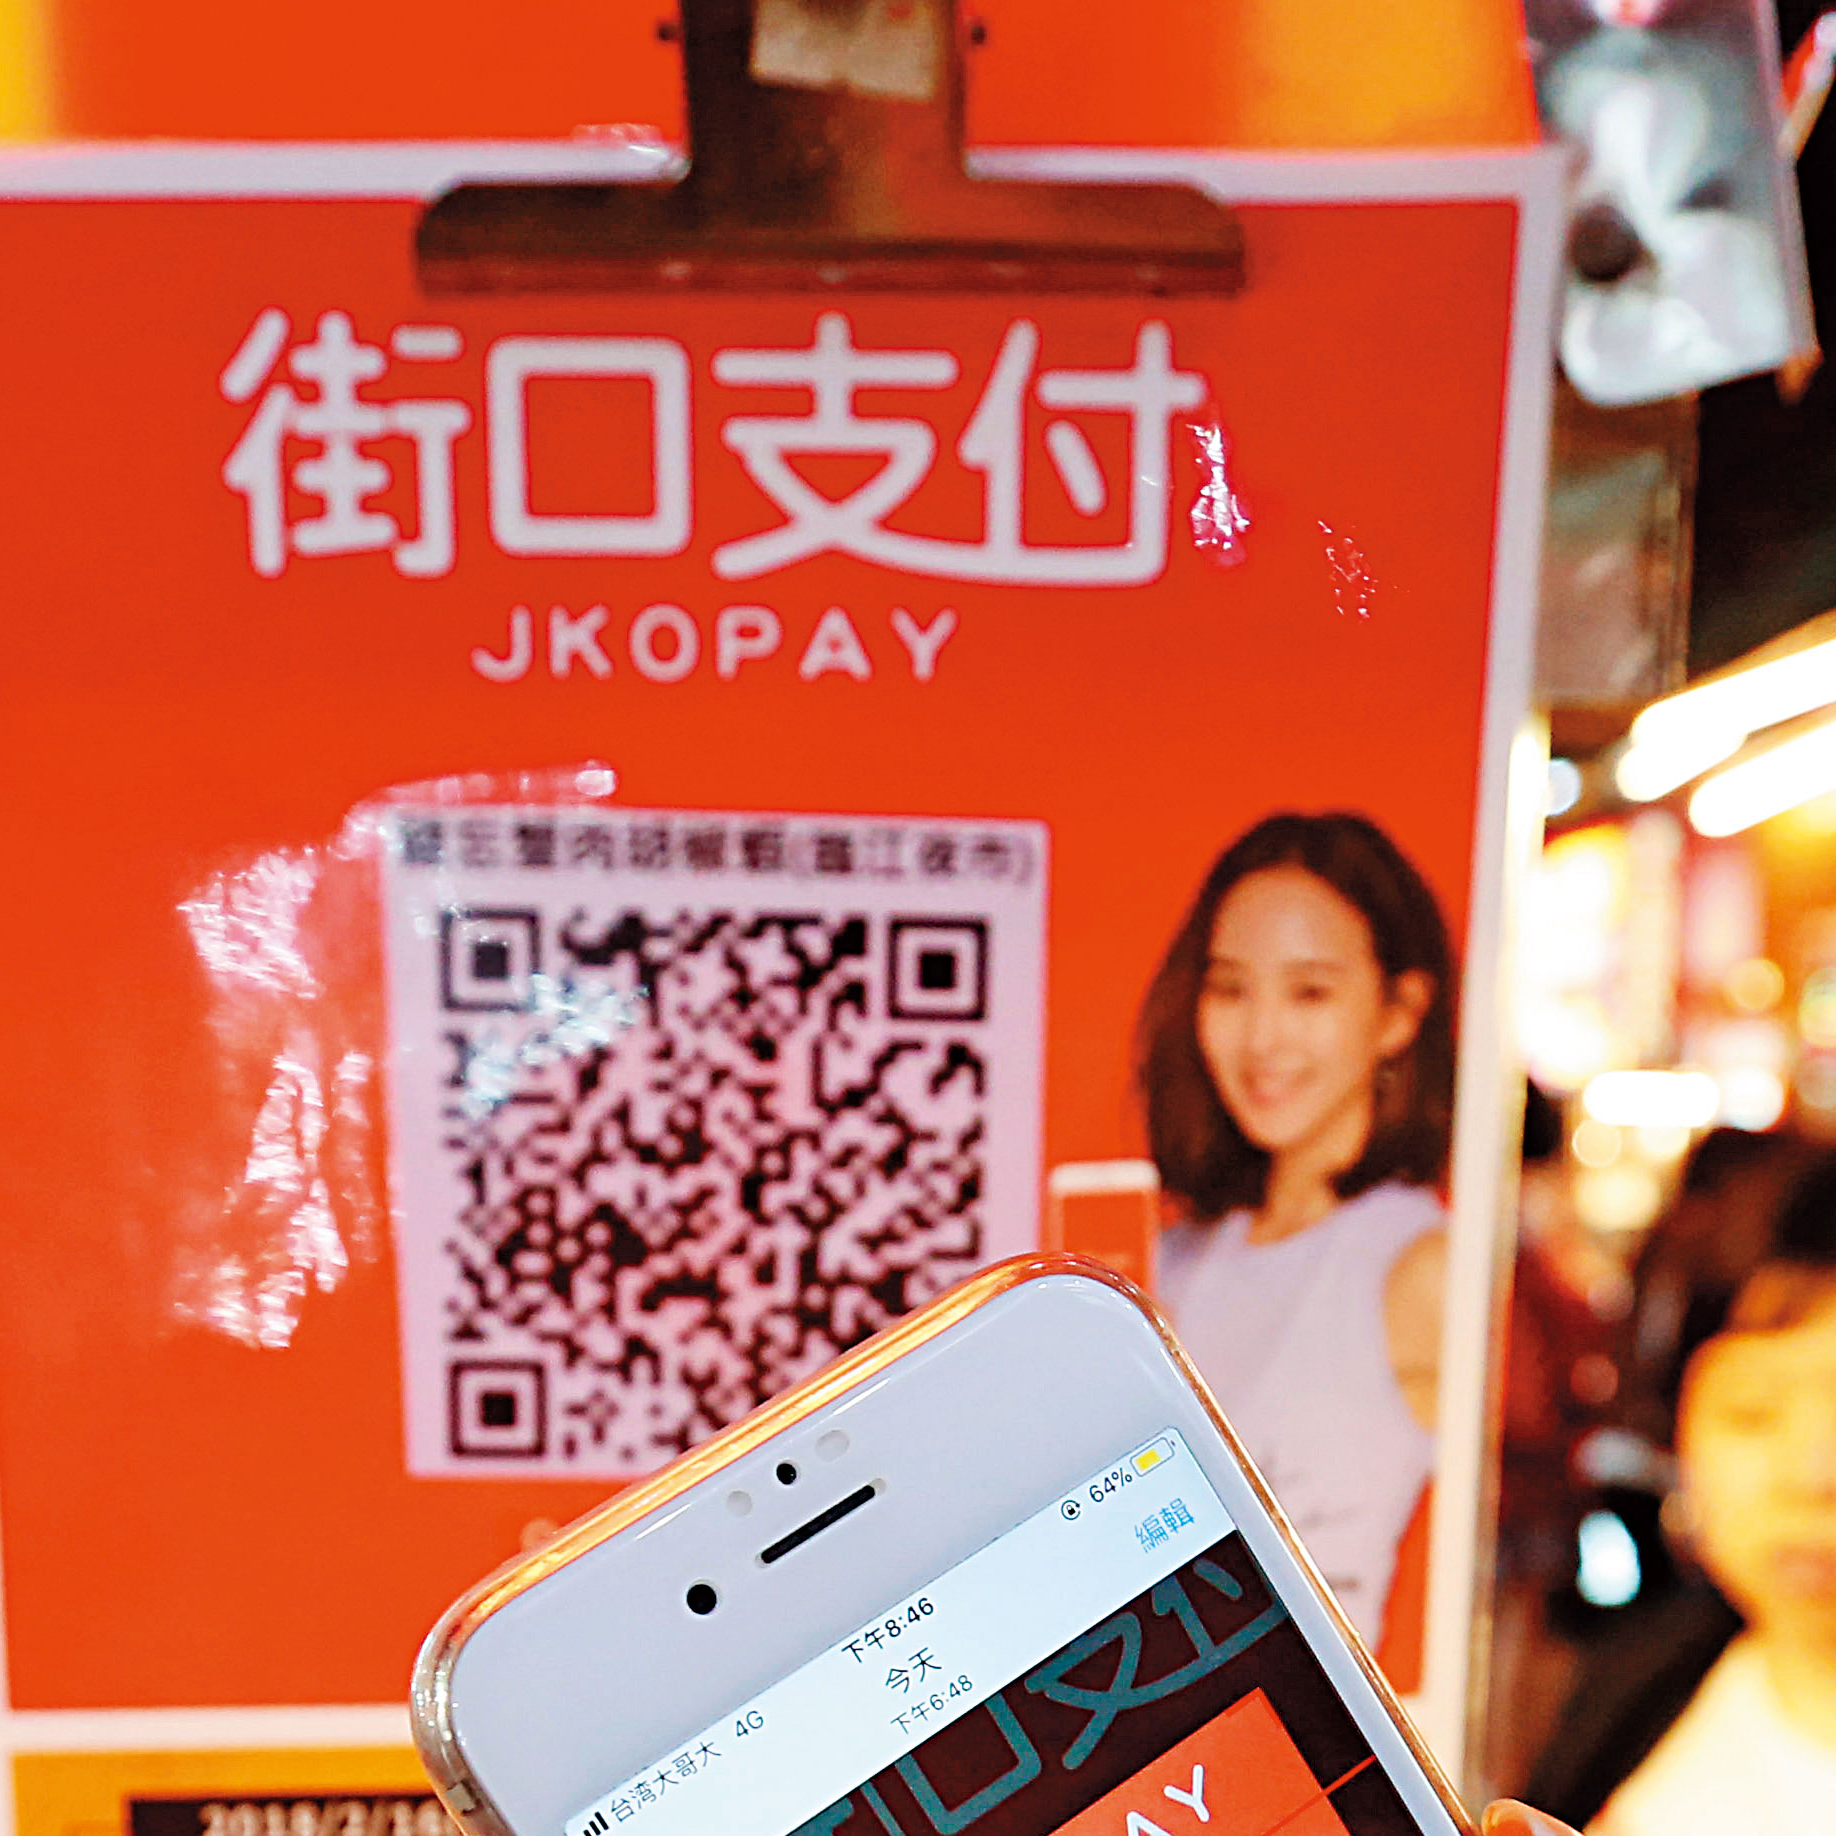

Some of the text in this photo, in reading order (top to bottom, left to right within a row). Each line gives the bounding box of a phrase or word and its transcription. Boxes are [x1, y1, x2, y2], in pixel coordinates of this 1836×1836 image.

[220, 306, 1207, 587] 街口支付
[473, 605, 957, 683] JKOPAY
[1089, 1467, 1133, 1503] 64%
[1134, 1497, 1195, 1553] 編輯
[841, 1597, 934, 1663] 下午8:46
[885, 1647, 942, 1693] 今天
[735, 1710, 764, 1737] 4G
[890, 1674, 973, 1734] 下午6:48
